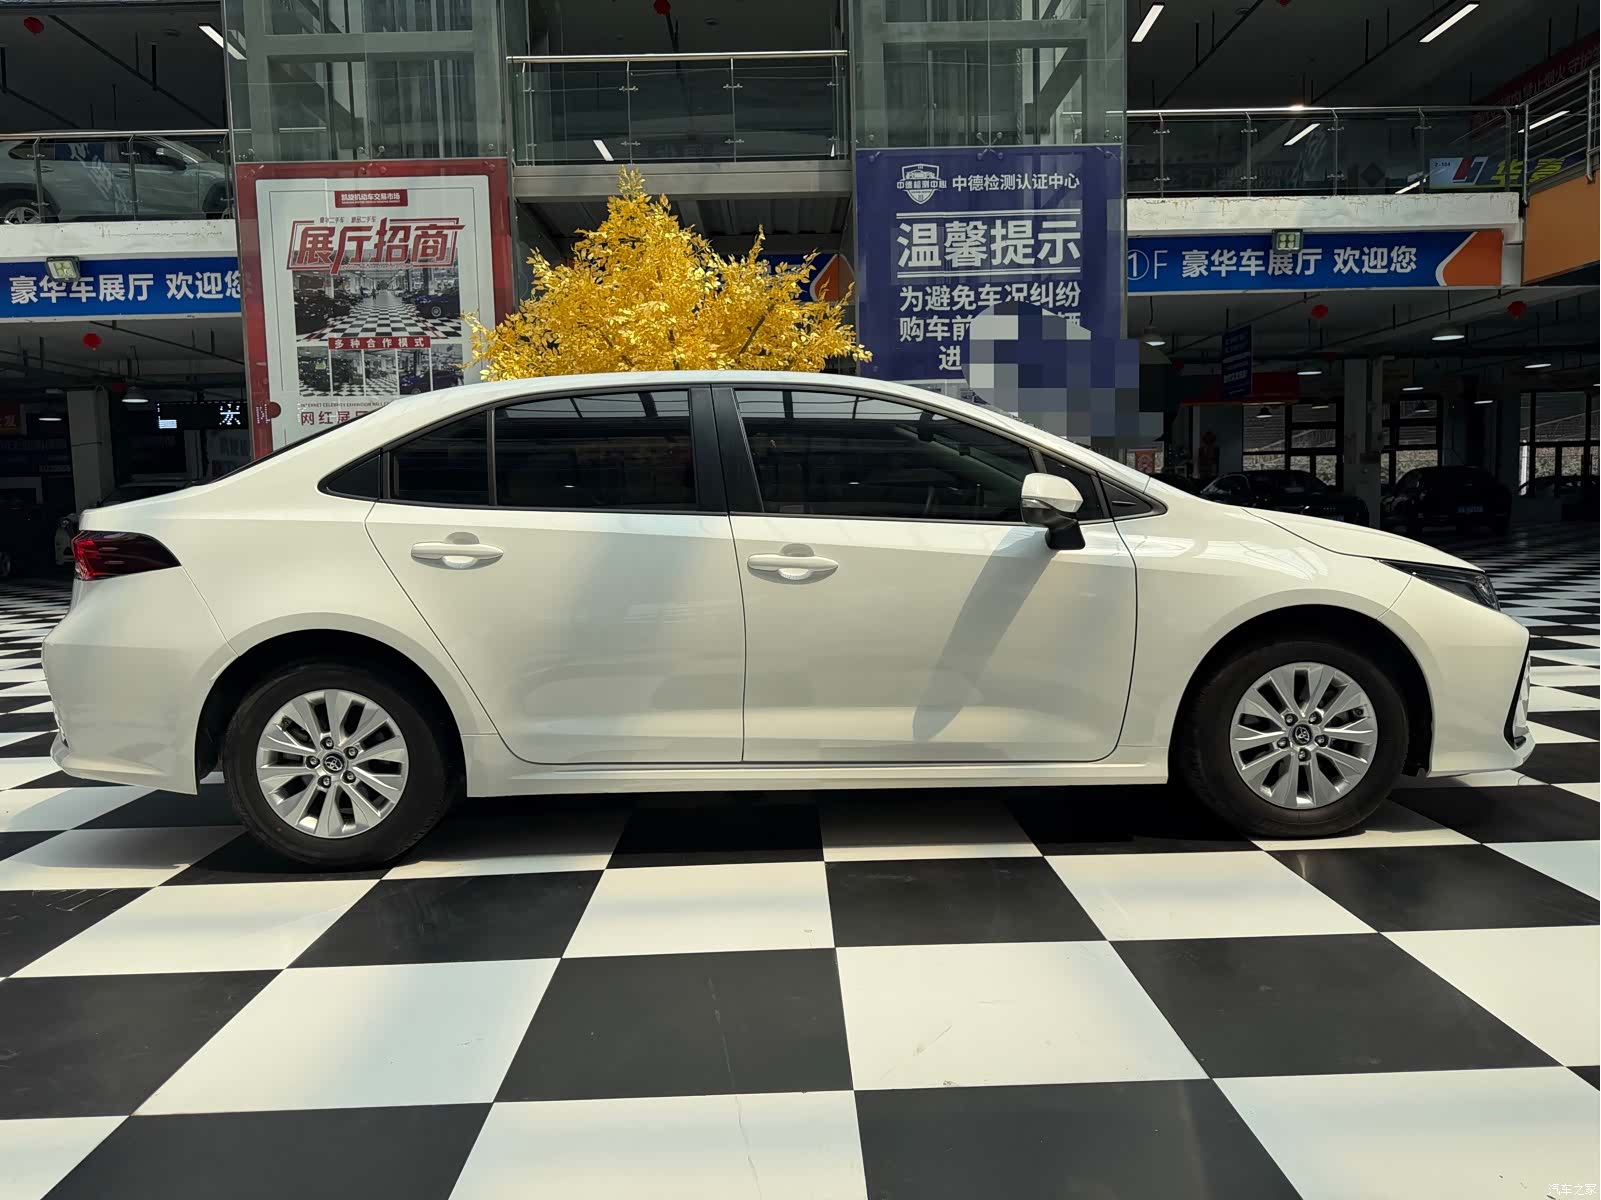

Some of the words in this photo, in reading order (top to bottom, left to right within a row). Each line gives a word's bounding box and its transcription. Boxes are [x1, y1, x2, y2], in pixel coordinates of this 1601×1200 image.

[952, 173, 1080, 192] 中德检测认证中心
[296, 217, 466, 275] 展厅招商
[897, 219, 1081, 268] 温馨提示
[1181, 249, 1322, 277] 豪华车展厅
[1333, 246, 1417, 274] 欢迎您
[9, 273, 154, 304] 豪华车展厅
[900, 281, 1081, 312] 为避免车况纠纷
[334, 337, 425, 349] 多种合作模式
